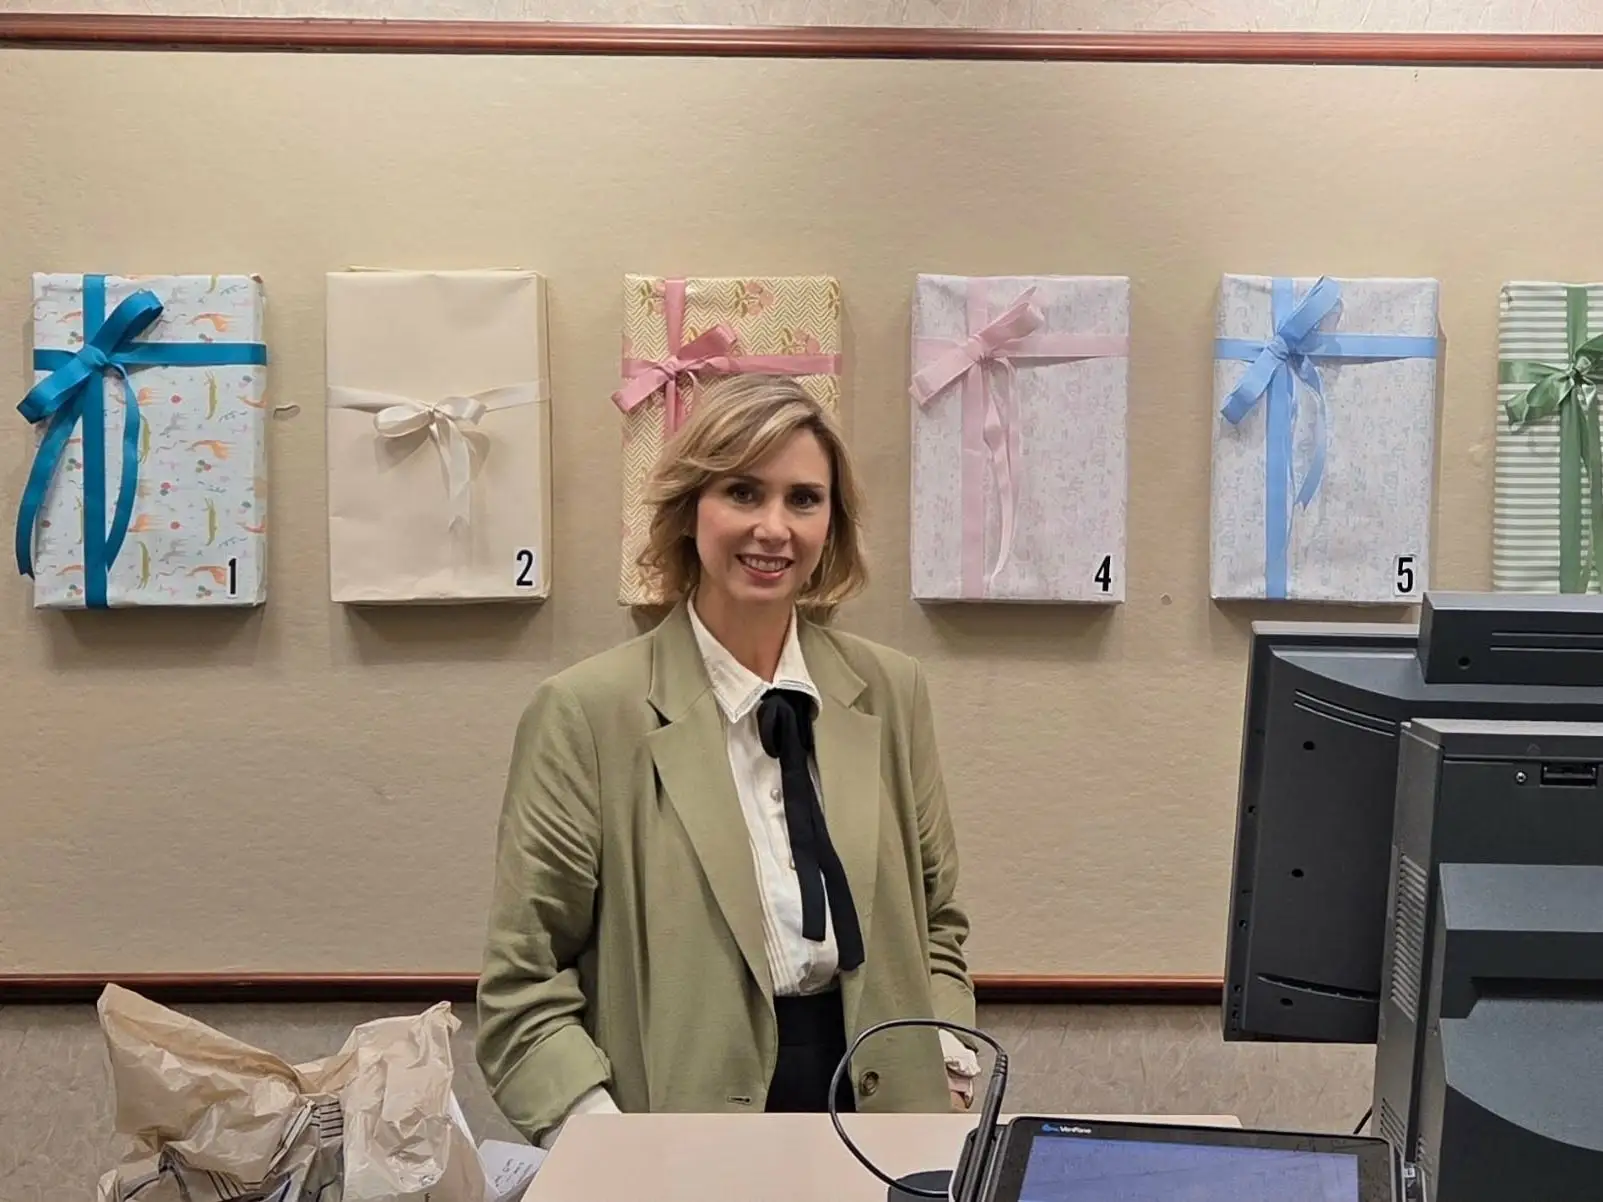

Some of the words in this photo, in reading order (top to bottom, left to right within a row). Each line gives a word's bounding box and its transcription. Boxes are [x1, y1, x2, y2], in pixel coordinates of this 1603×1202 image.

[228, 558, 237, 595] 1
[516, 549, 534, 586] 2
[1094, 555, 1112, 593] 4
[1396, 556, 1414, 593] 5
